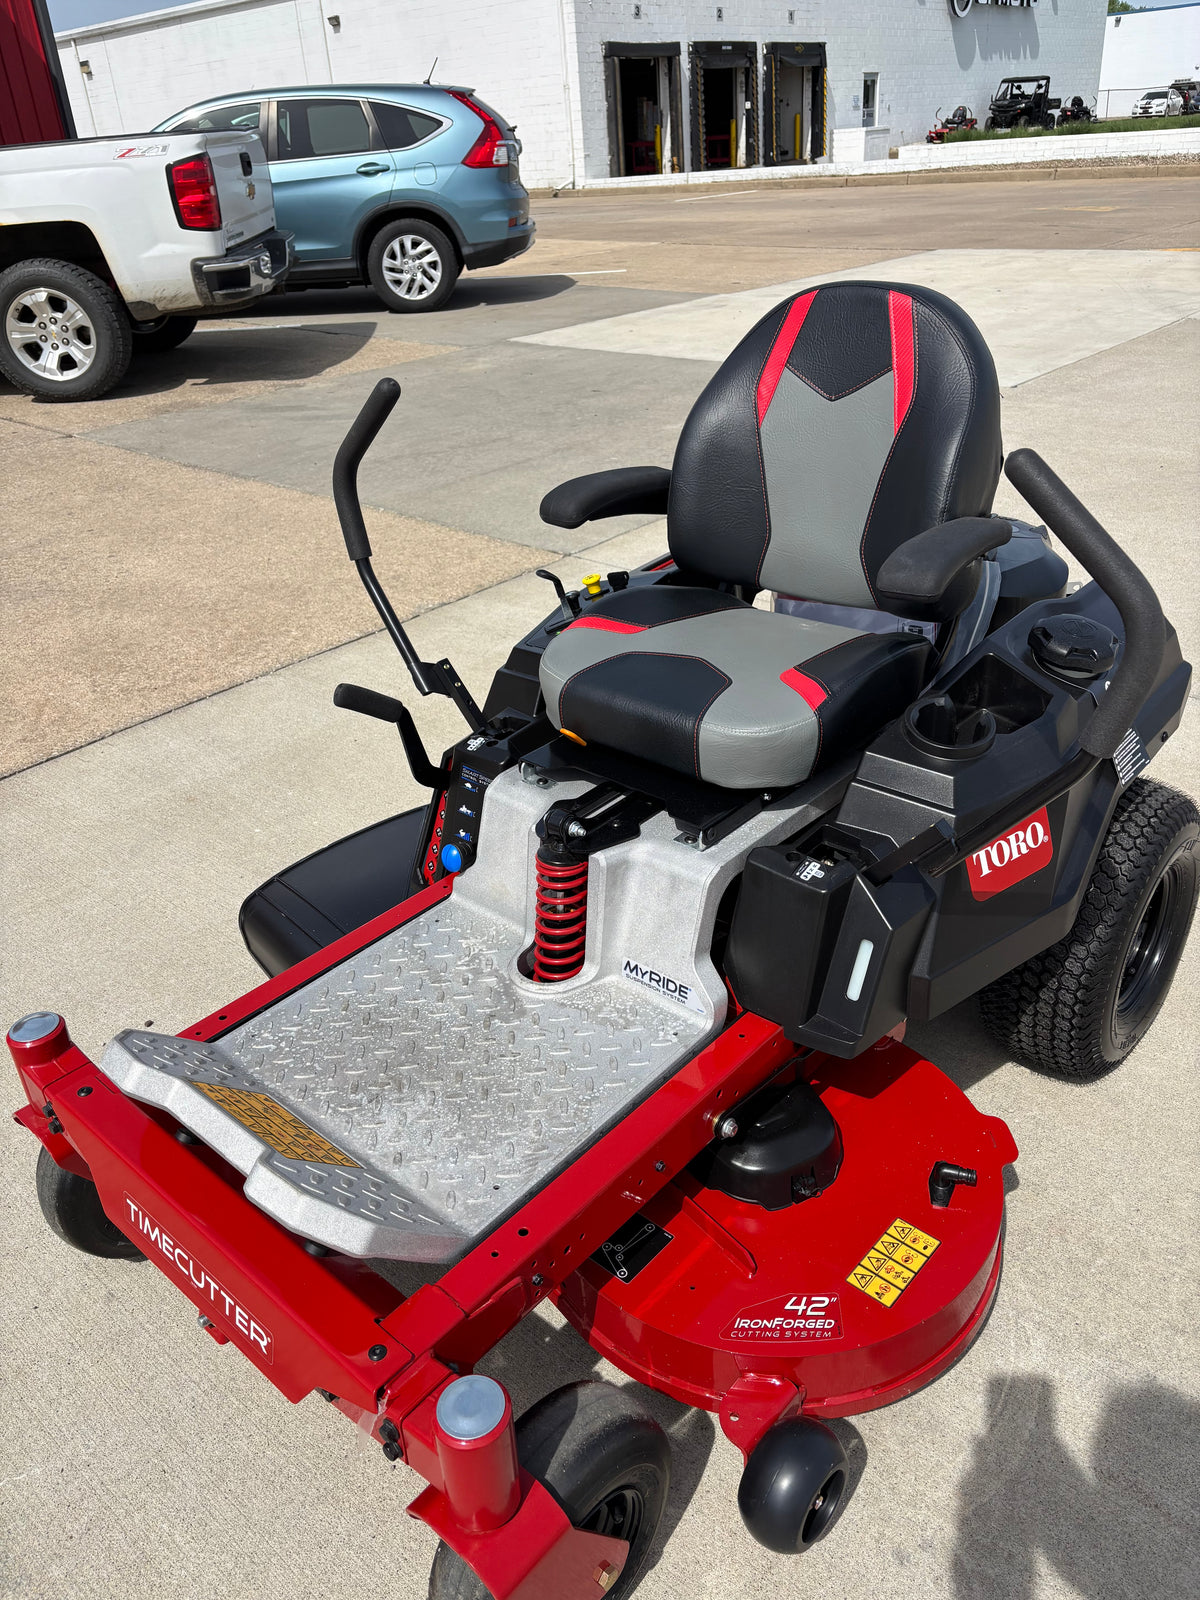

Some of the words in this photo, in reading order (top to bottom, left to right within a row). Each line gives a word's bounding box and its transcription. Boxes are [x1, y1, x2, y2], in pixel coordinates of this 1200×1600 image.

[717, 9, 722, 18] 2
[625, 973, 661, 993] SUSPENSION
[662, 990, 686, 1005] SYSTEM
[126, 1198, 268, 1355] TIMECUTTER
[734, 1317, 835, 1329] IRONFORGED
